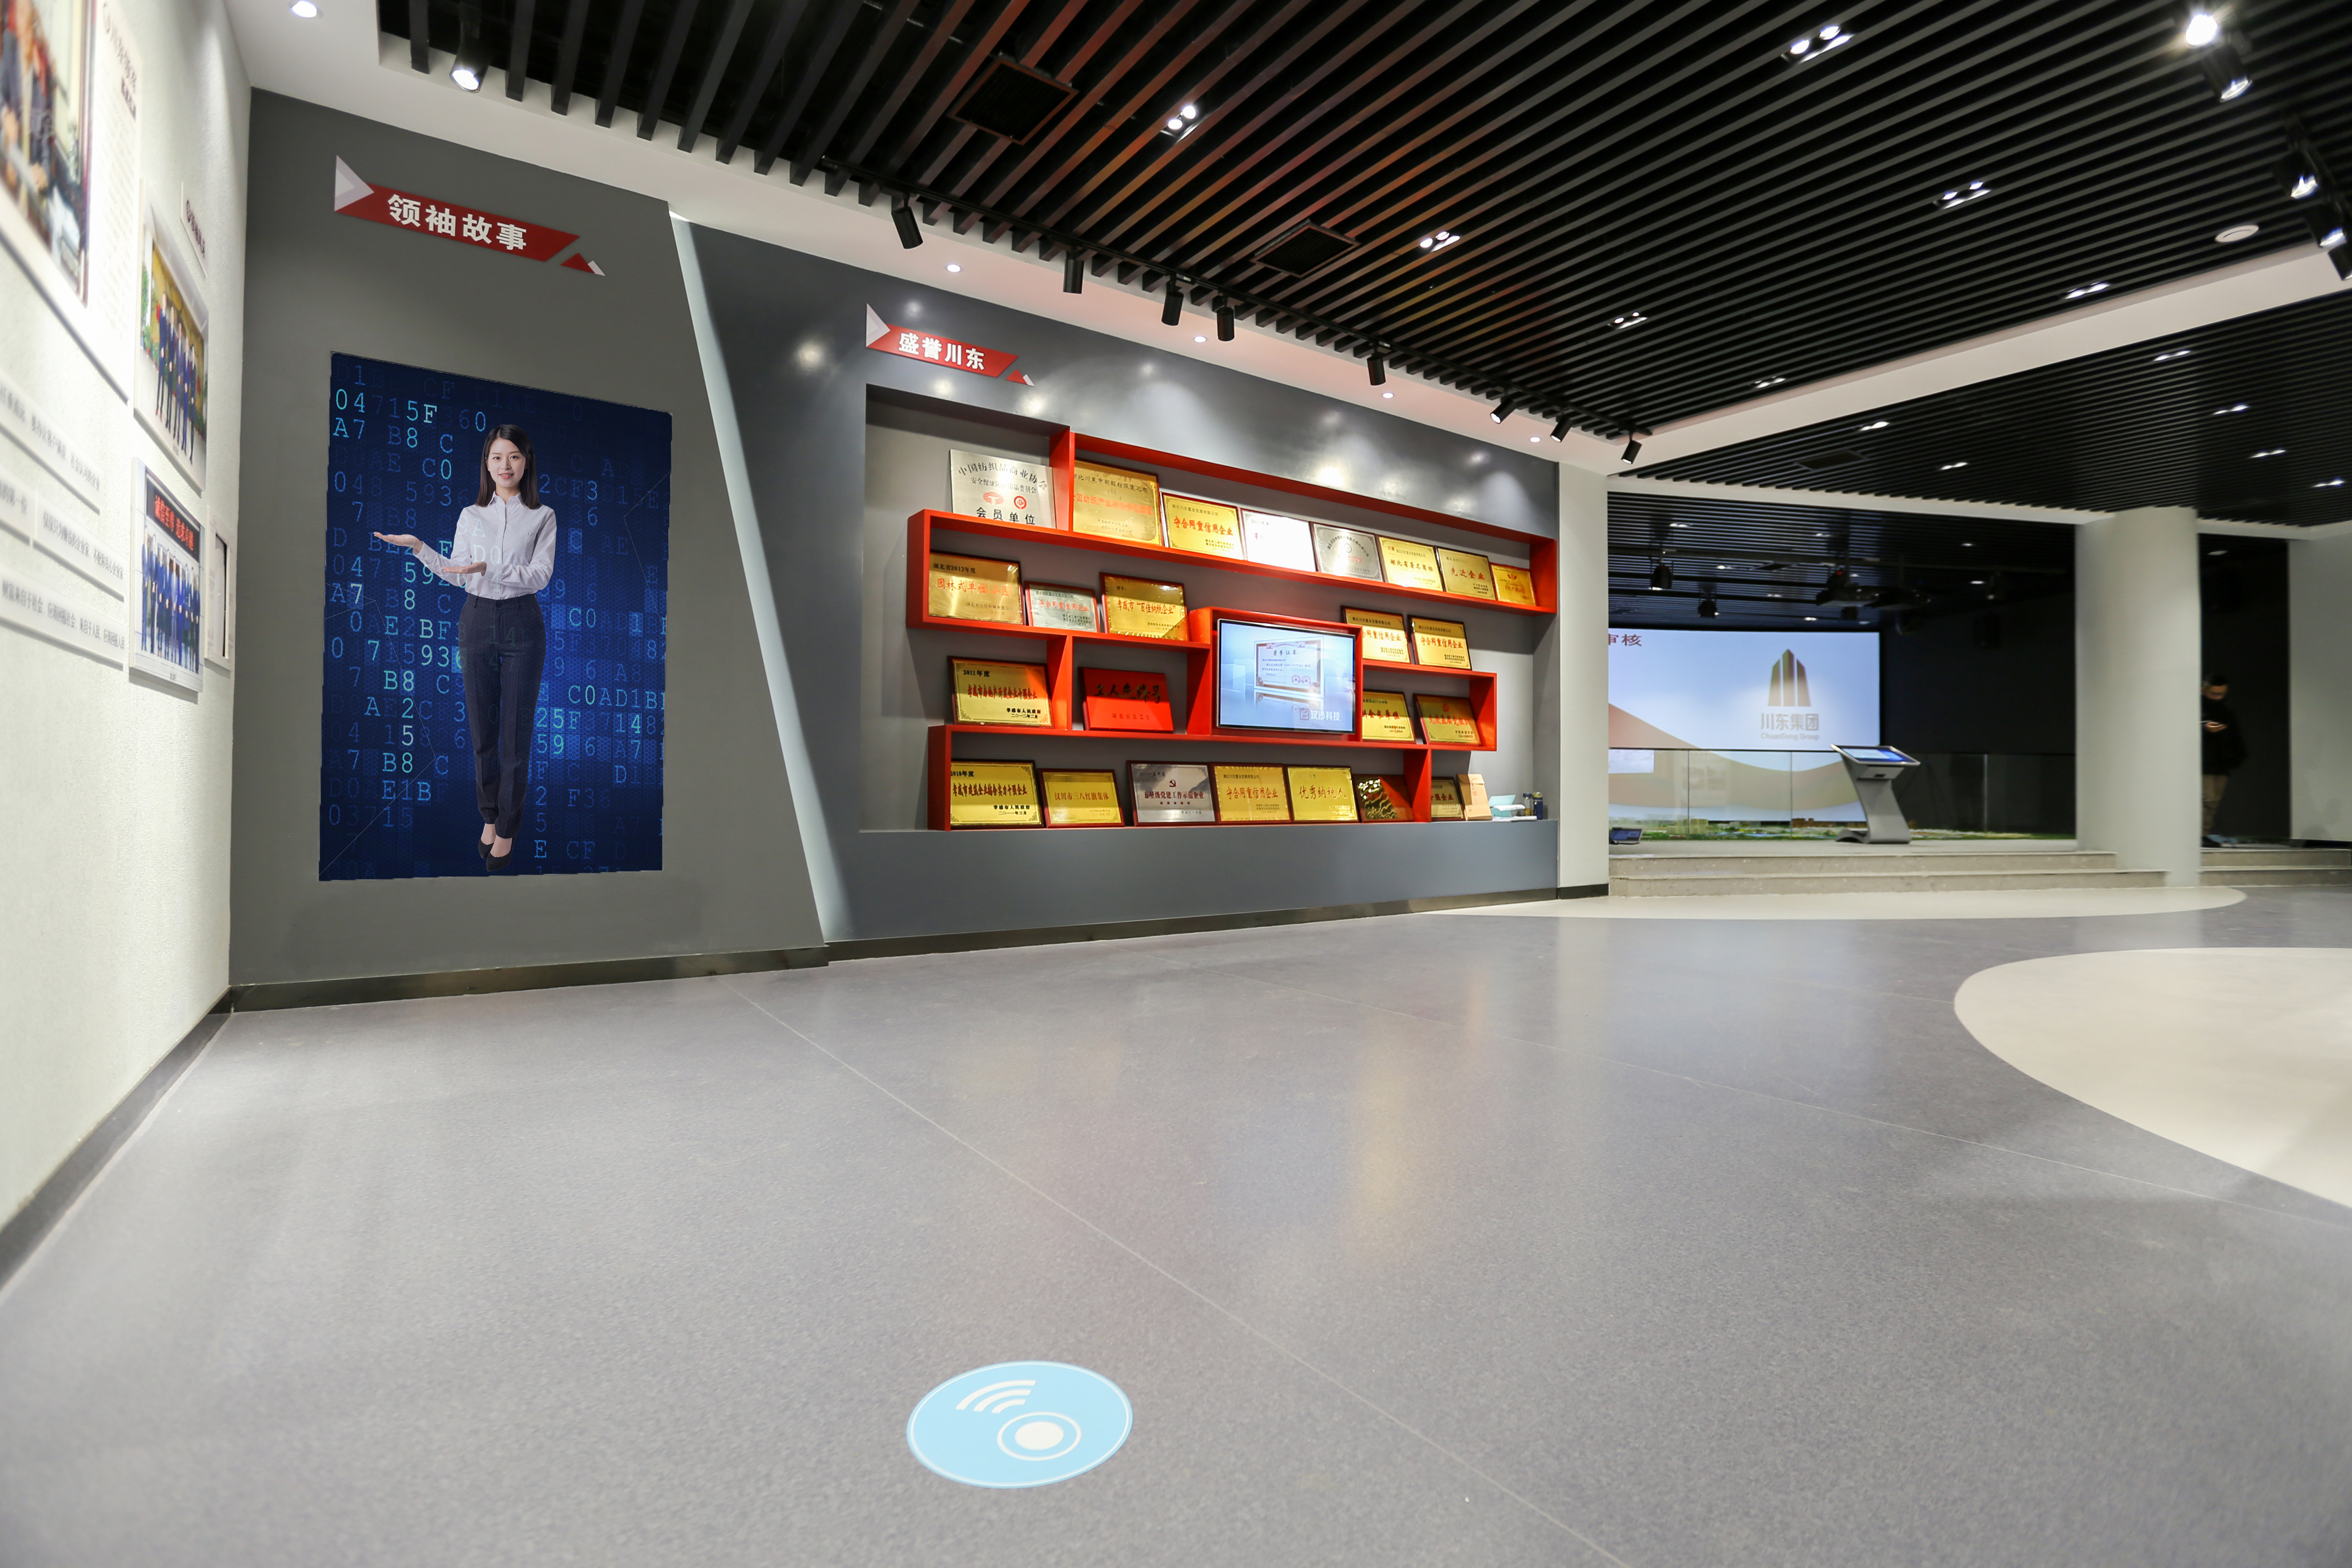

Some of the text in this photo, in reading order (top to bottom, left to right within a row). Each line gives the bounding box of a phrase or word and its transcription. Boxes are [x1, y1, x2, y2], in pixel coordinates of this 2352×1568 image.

[388, 194, 527, 251] 领袖故事
[899, 332, 985, 371] 盛誉川东
[958, 462, 1048, 490] 中国纺织品商业协会
[976, 507, 1035, 525] 会员单位
[1173, 516, 1233, 535] 守合同重信用企业
[933, 563, 976, 574] 湖北省2012年度
[1451, 566, 1485, 580] 先进企业
[1095, 682, 1162, 704] 工人先锋号
[1311, 710, 1340, 721] 汉沙科技
[1761, 713, 1819, 731] 川东集团
[1055, 792, 1109, 801] 汉川市三八红旗集体
[1226, 786, 1279, 800] 守合同重信用企业
[1299, 785, 1348, 800] 优秀纳税人
